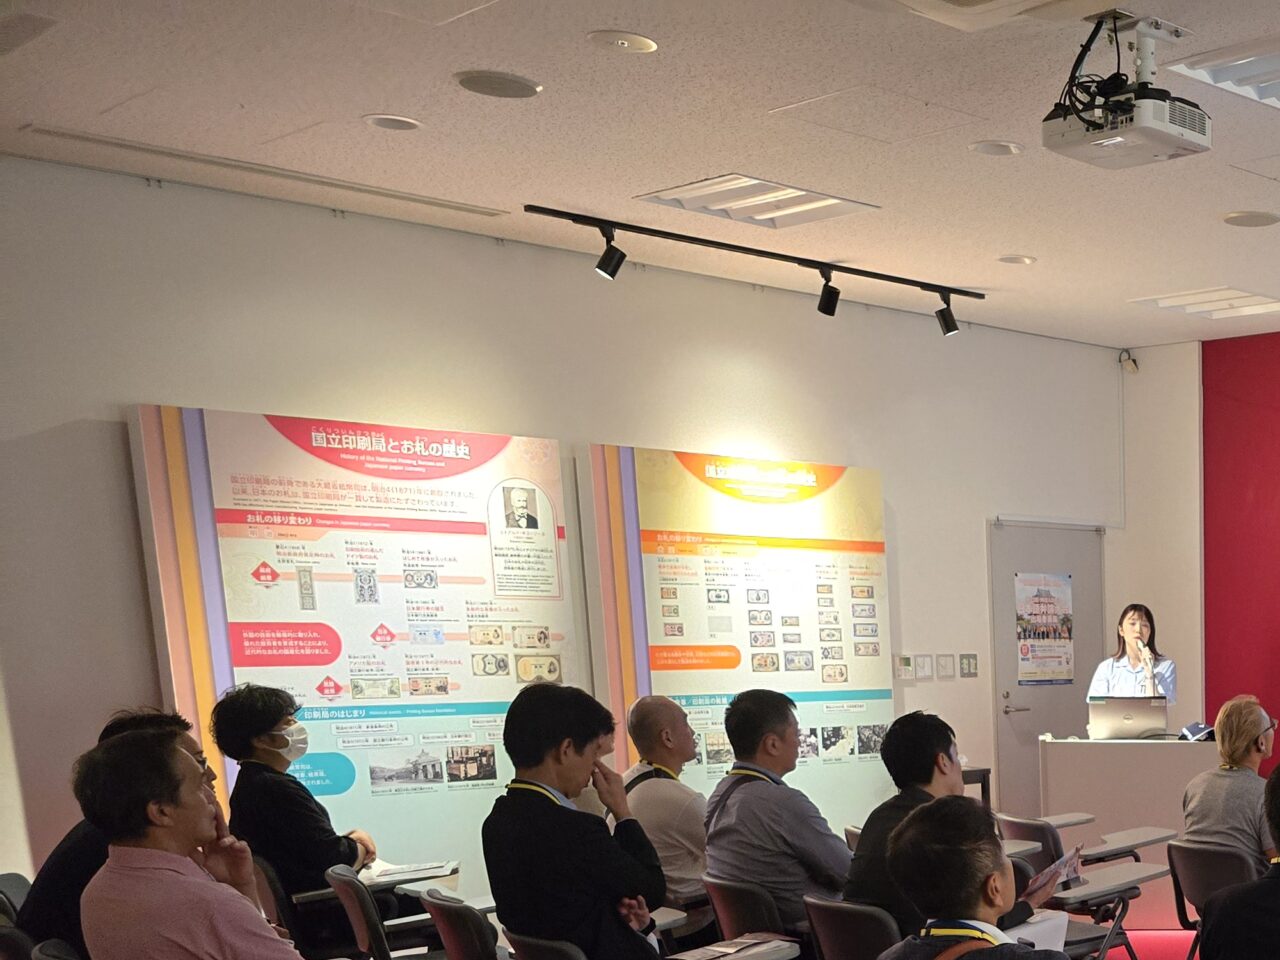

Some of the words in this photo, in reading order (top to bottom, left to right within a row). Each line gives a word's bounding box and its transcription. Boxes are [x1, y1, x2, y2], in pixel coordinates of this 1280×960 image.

[312, 432, 471, 460] 国立印刷局とお札の歴史
[246, 513, 312, 526] お札の移り変わり
